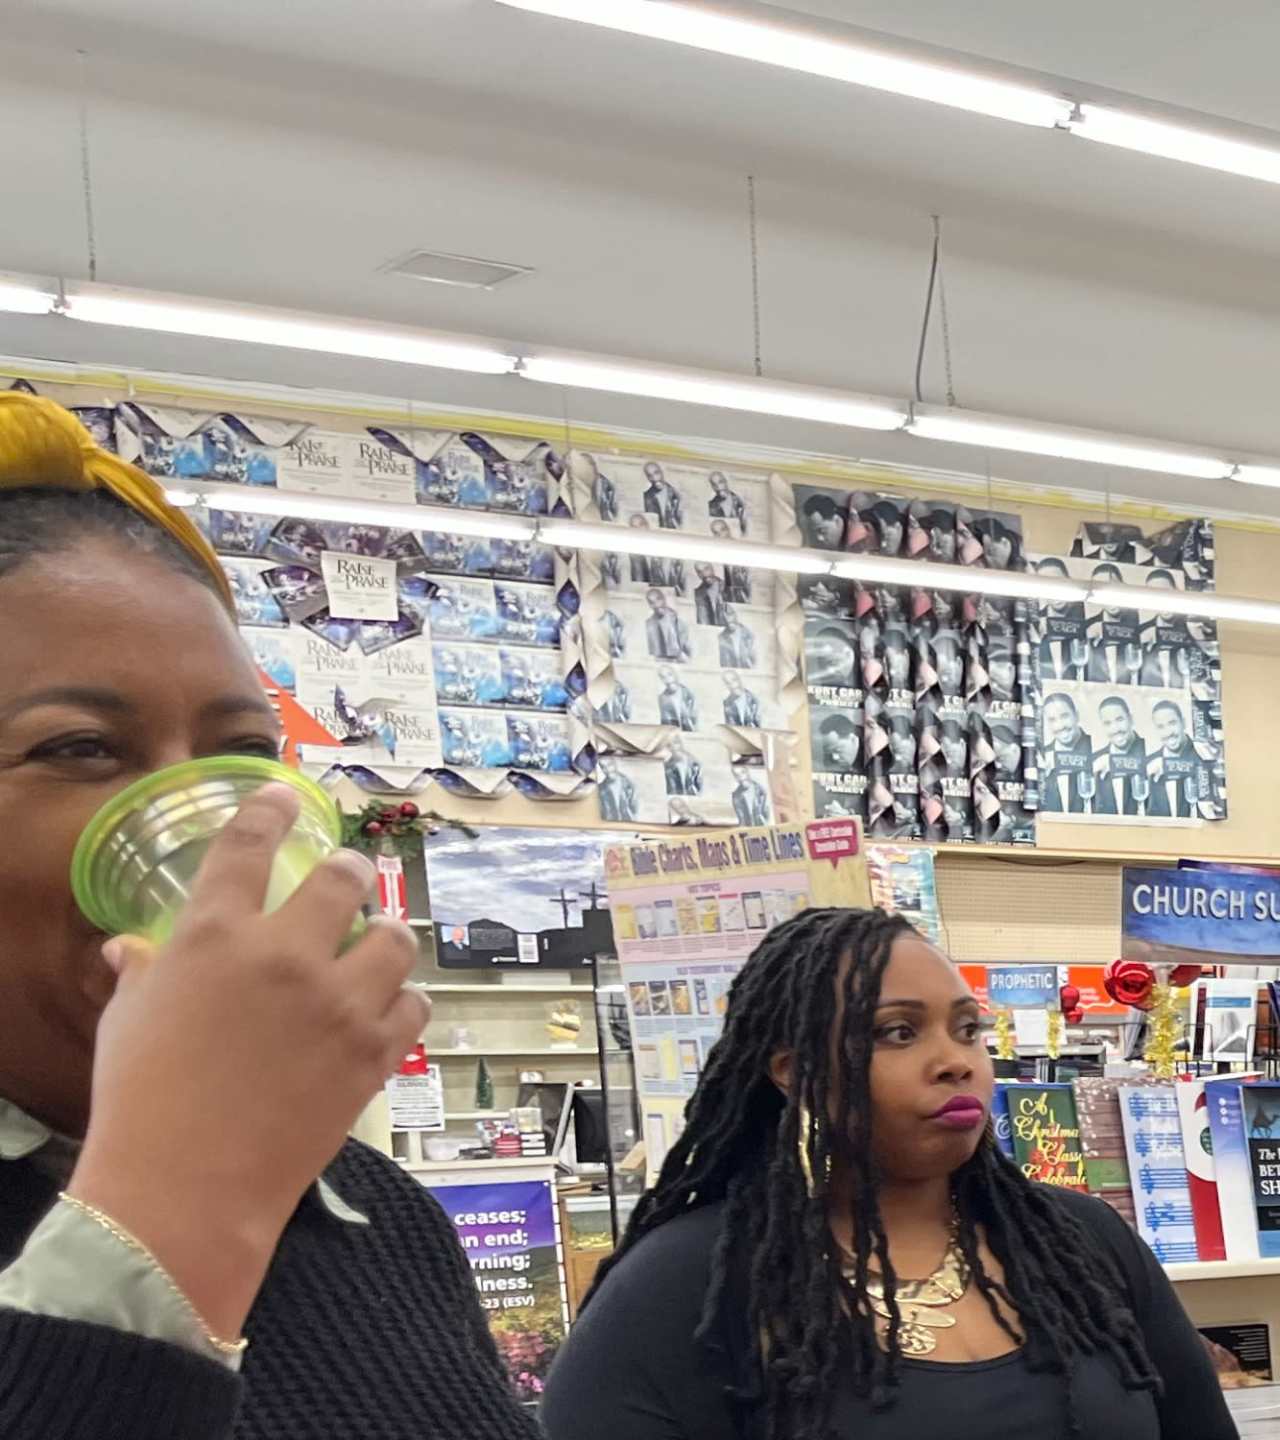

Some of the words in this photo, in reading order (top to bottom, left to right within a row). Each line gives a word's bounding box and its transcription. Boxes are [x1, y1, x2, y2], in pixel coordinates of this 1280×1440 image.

[337, 559, 375, 575] RAISE
[345, 573, 388, 590] PRAISE
[1132, 884, 1248, 920] CHURCH
[991, 973, 1054, 989] PROPHETIC
[1013, 1115, 1079, 1140] Christma
[1258, 1149, 1276, 1160] The
[454, 1209, 527, 1226] ceases;
[484, 1229, 529, 1246] end;
[469, 1252, 531, 1271] rning;
[503, 1295, 536, 1309] (ESV)
